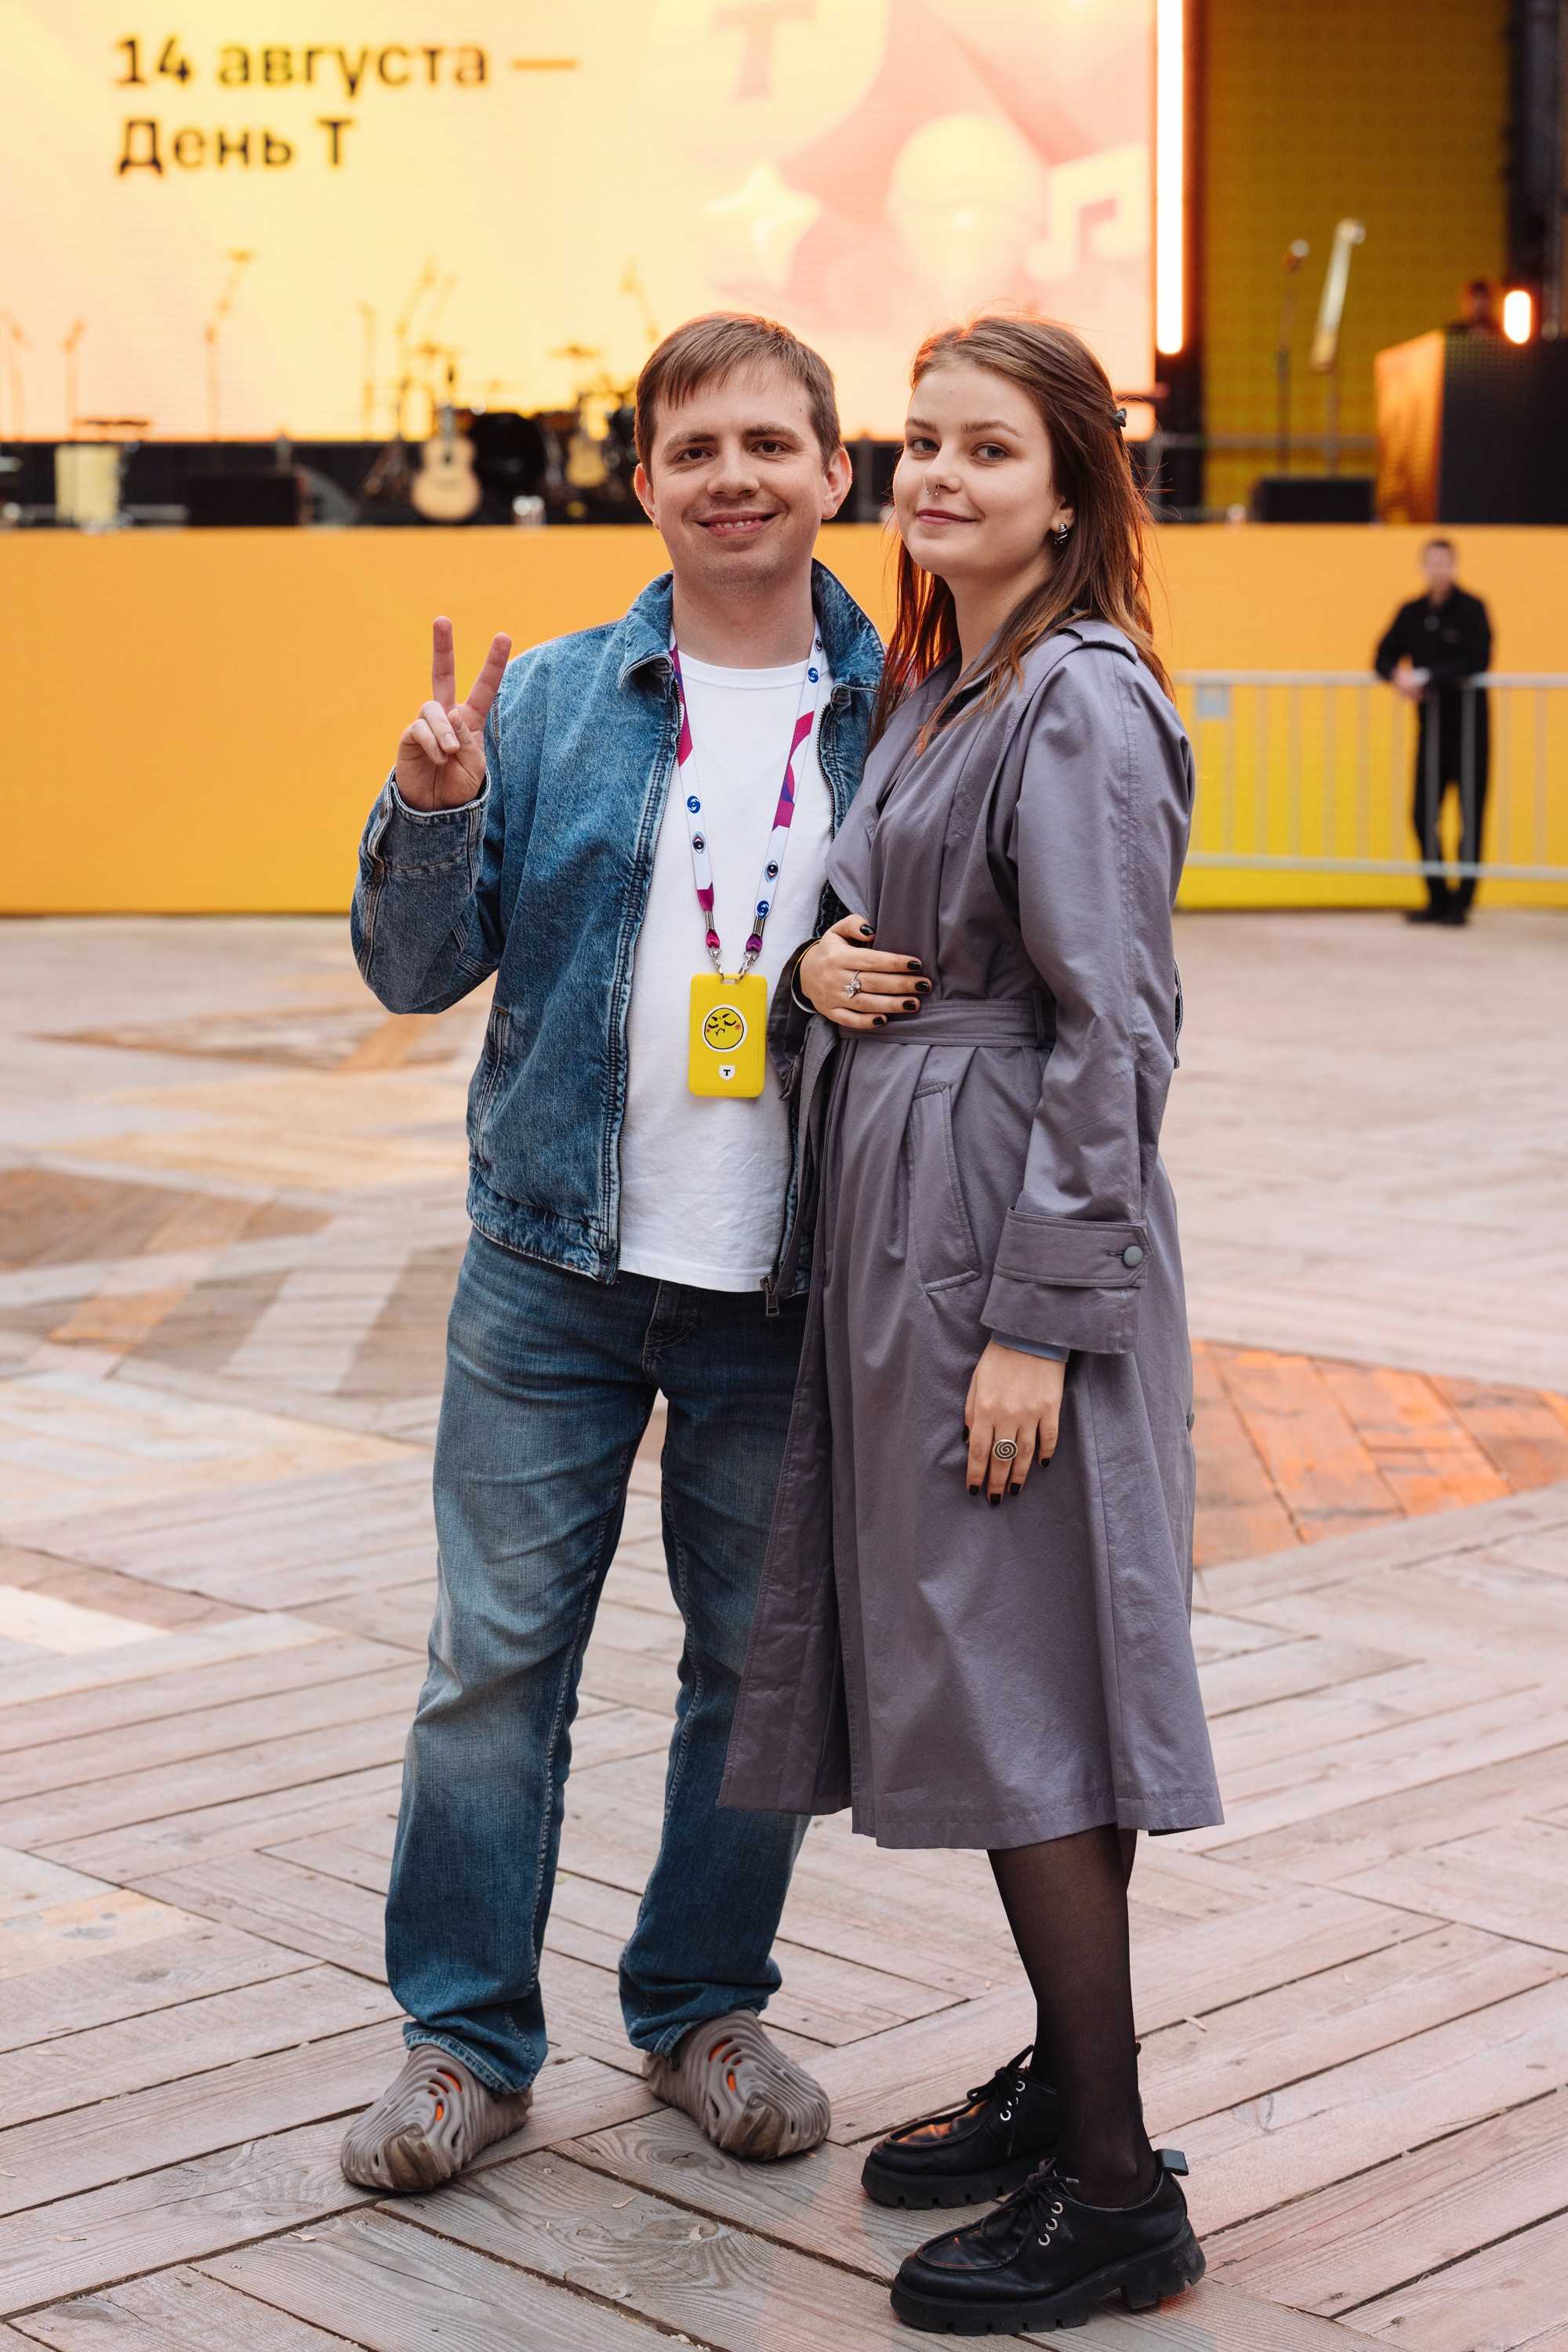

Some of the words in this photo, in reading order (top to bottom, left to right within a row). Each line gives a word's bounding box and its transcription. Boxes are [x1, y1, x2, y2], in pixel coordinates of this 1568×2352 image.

[116, 38, 191, 85] 14
[219, 45, 488, 98] августа
[118, 119, 293, 176] День
